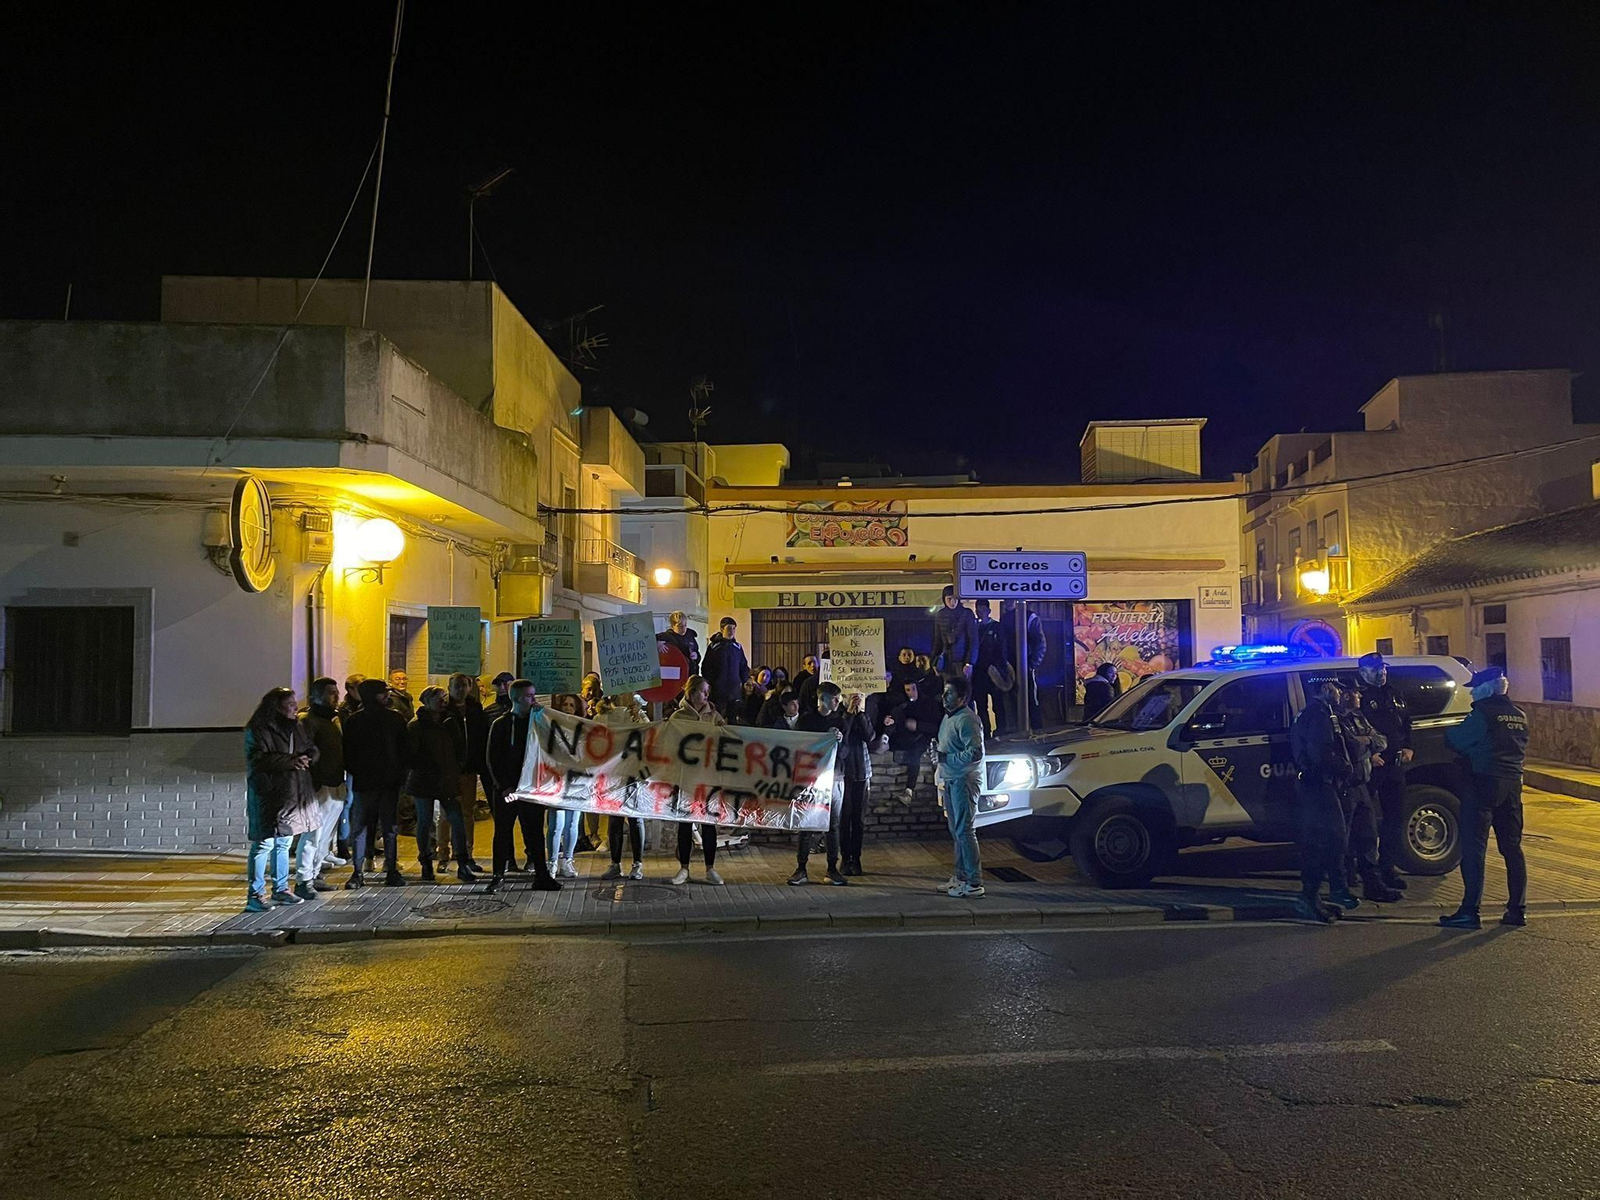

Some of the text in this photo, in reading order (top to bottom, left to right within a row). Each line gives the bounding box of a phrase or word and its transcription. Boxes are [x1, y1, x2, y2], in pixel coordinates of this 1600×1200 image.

[988, 559, 1049, 570] Correos
[975, 579, 1052, 592] Mercado
[777, 591, 907, 607] EL POYETE
[1091, 608, 1165, 624] FRUTERÍA
[1097, 626, 1160, 644] Adela
[850, 639, 860, 647] DE
[604, 667, 619, 677] POR
[611, 678, 625, 687] DEL
[548, 718, 824, 783] NO AL CIERRE
